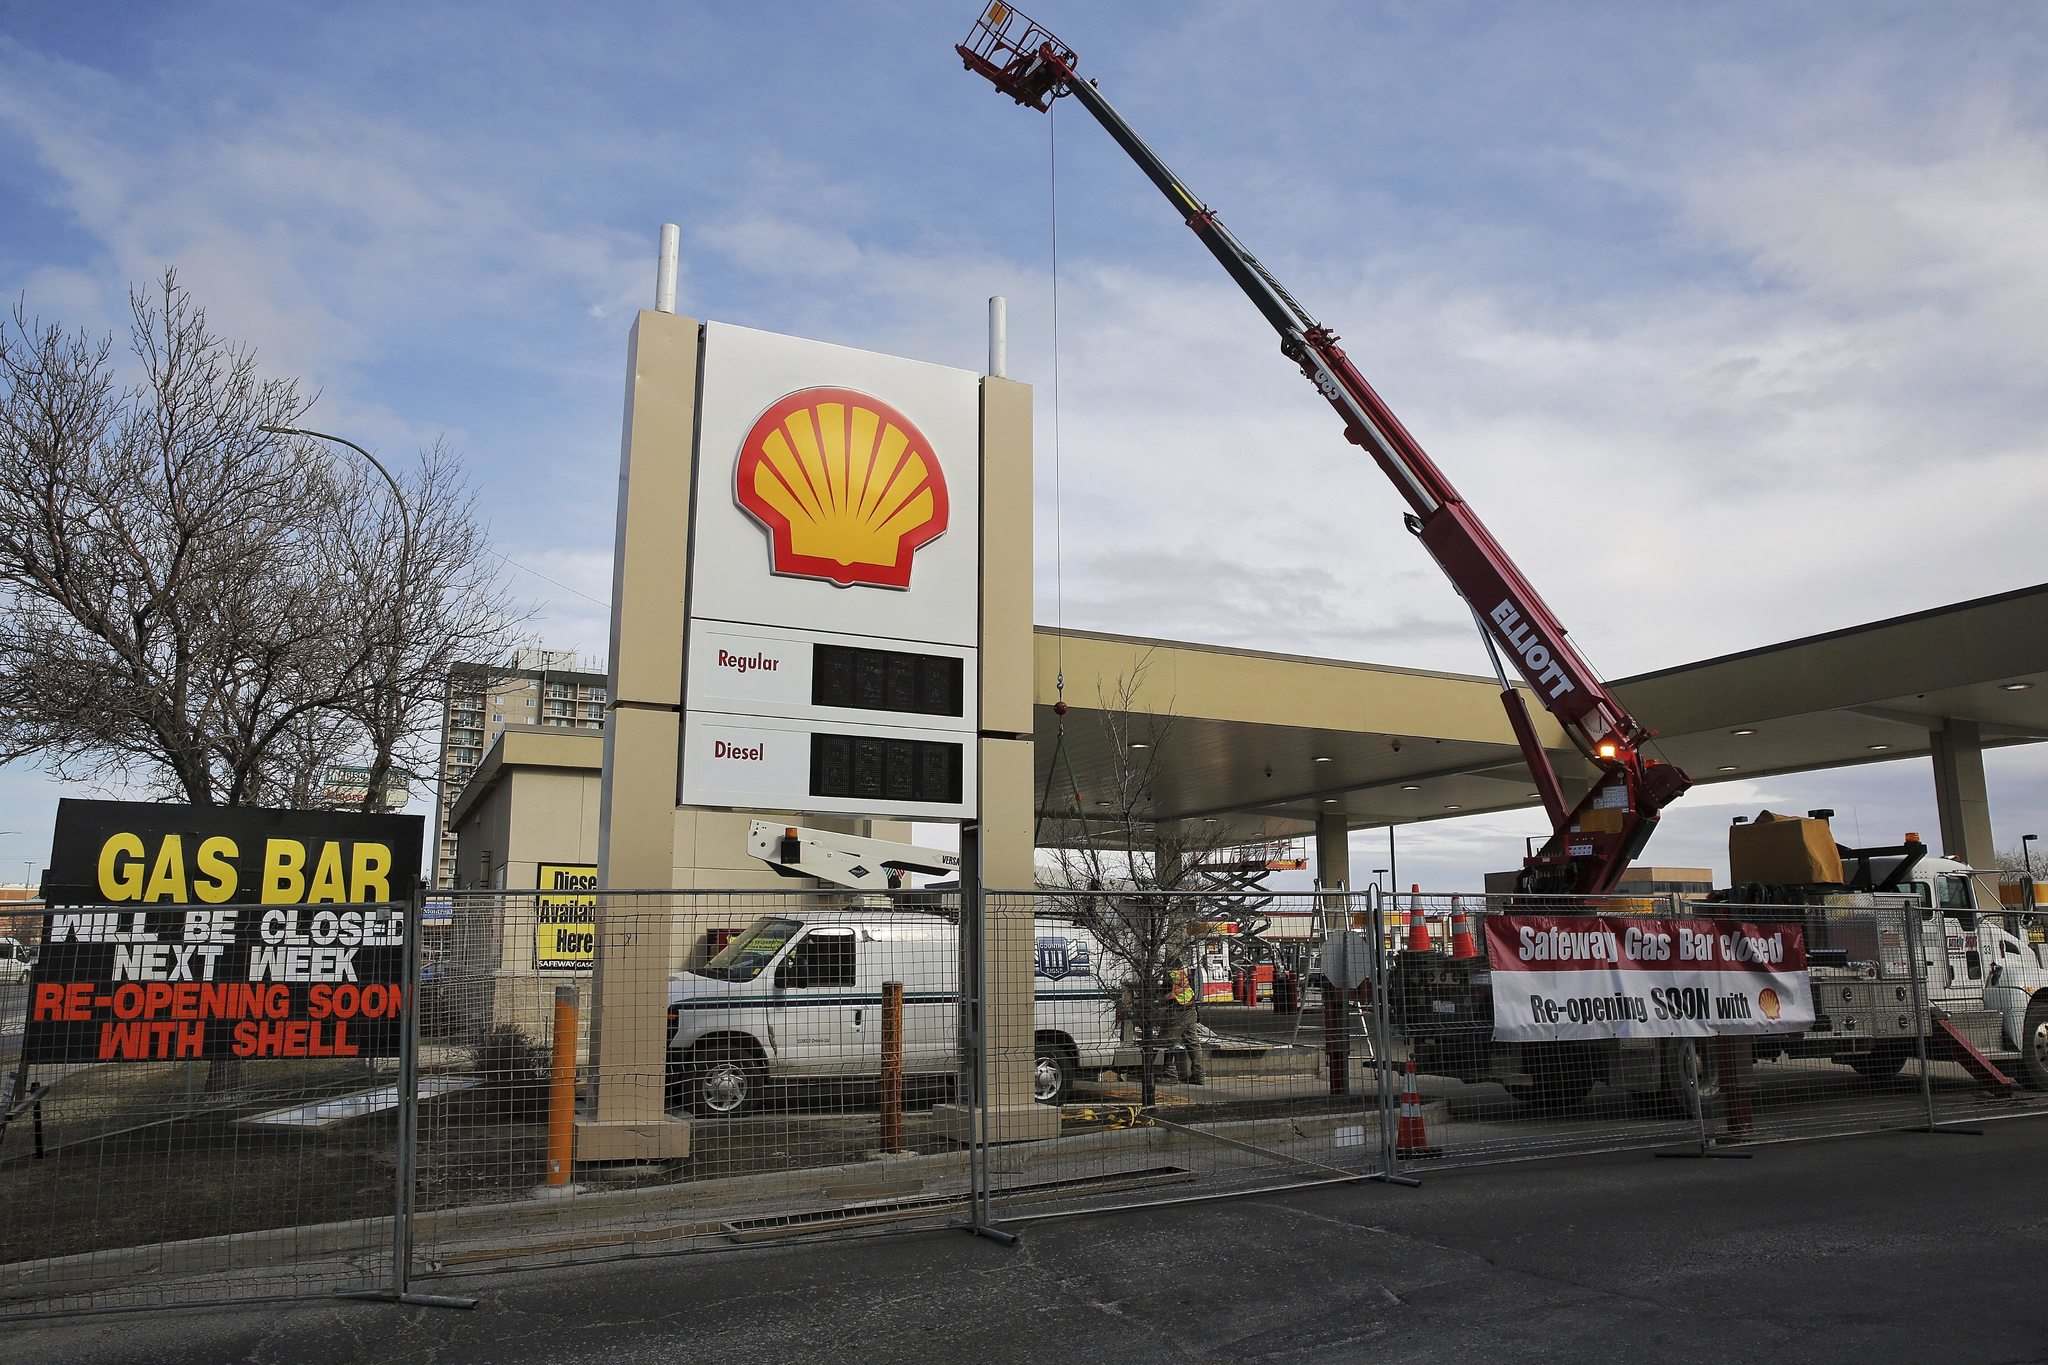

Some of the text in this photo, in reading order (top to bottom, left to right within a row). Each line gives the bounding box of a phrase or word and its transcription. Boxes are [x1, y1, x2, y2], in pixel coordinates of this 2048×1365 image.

[718, 649, 779, 673] Regular
[1490, 598, 1576, 699] ELLIOTT
[714, 740, 764, 761] Diesel
[98, 832, 392, 905] GAS BAR
[51, 905, 404, 946] WILL BE CLOSED
[556, 928, 593, 953] Here
[112, 944, 360, 982] NEXT WEEK
[1519, 926, 1784, 963] Safeway Gas Bar closed
[539, 960, 576, 968] SAFEWAY
[33, 982, 413, 1021] RE-OPENING SOON
[1530, 987, 1752, 1024] Re-opening SOON with
[98, 1020, 359, 1060] WITH SHELL
